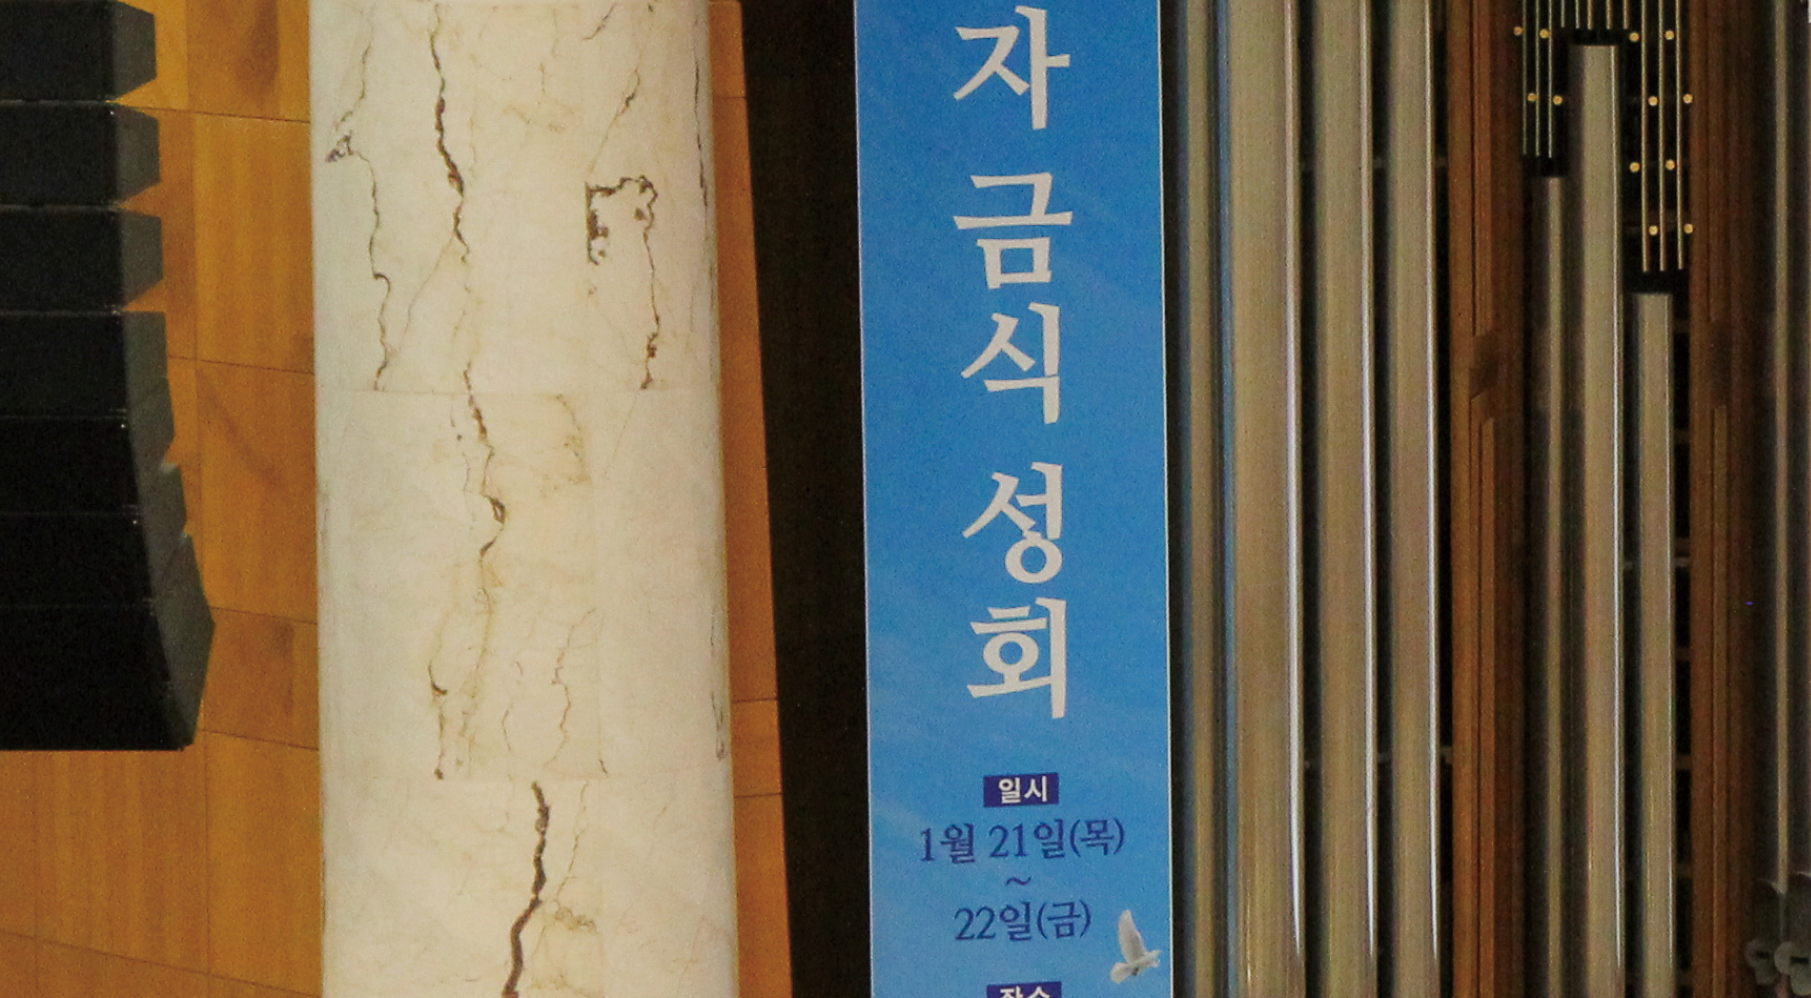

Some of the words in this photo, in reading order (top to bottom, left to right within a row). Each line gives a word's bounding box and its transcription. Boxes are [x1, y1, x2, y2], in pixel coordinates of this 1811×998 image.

[953, 5, 1071, 130] 자
[953, 172, 1073, 425] 금식
[962, 461, 1067, 719] 성회
[997, 775, 1049, 805] 일시
[919, 822, 976, 864] 1월
[988, 817, 1126, 859] 21일(목)
[953, 899, 1092, 942] 22일(금)
